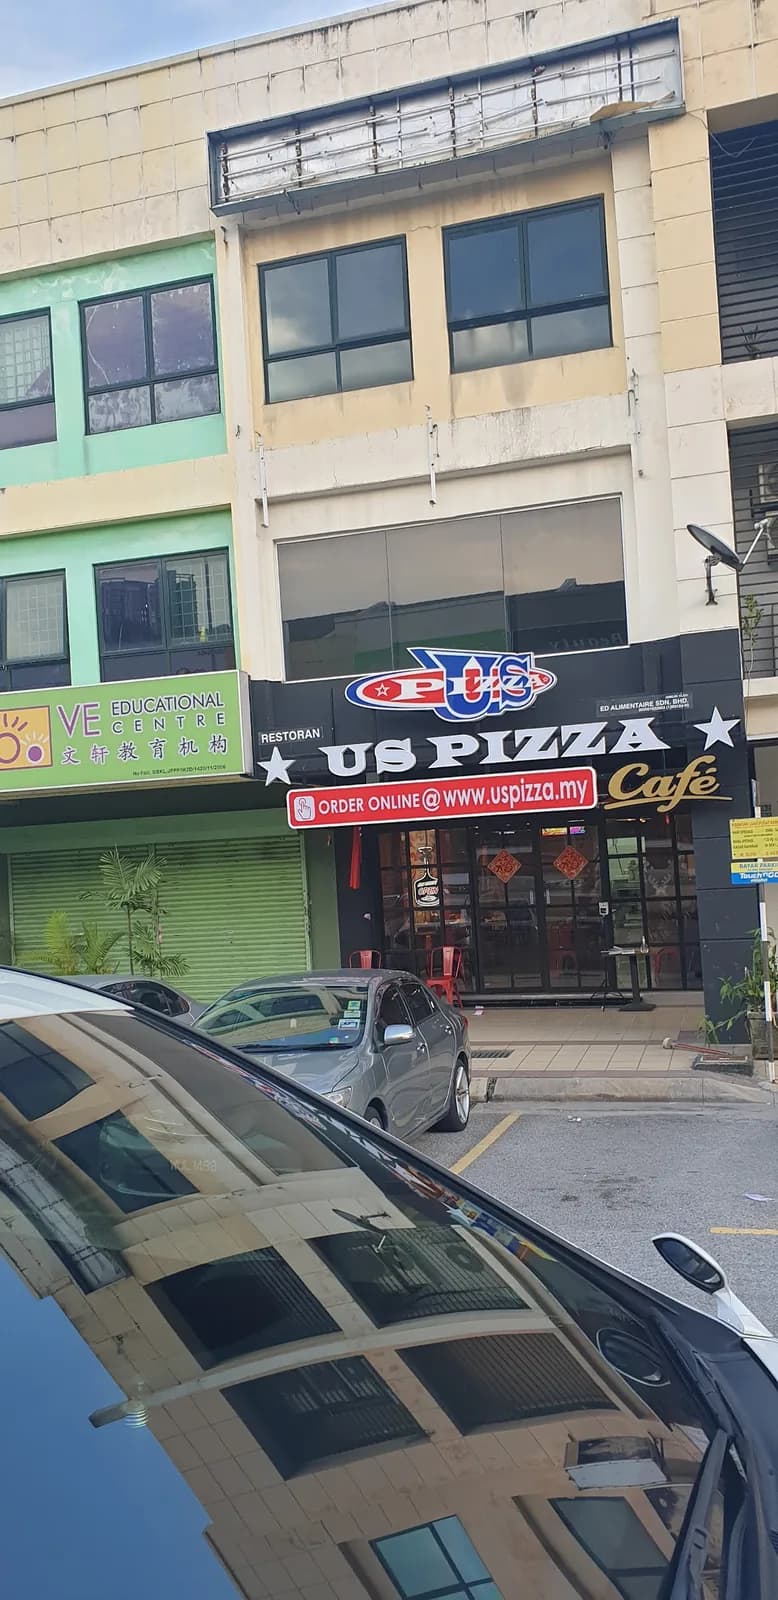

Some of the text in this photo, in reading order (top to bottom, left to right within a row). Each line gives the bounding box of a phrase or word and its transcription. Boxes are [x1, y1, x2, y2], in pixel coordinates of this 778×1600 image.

[112, 692, 224, 716] EDUCATIONAL
[57, 703, 101, 736] VE
[112, 712, 225, 734] CENTRE
[261, 728, 321, 744] RESTORAN
[318, 717, 671, 777] US PIZZA
[61, 736, 227, 765] 文轩教育机构
[604, 754, 720, 813] Café
[318, 798, 364, 815] ORDER
[368, 793, 420, 811] ONLINE
[422, 788, 440, 812] @
